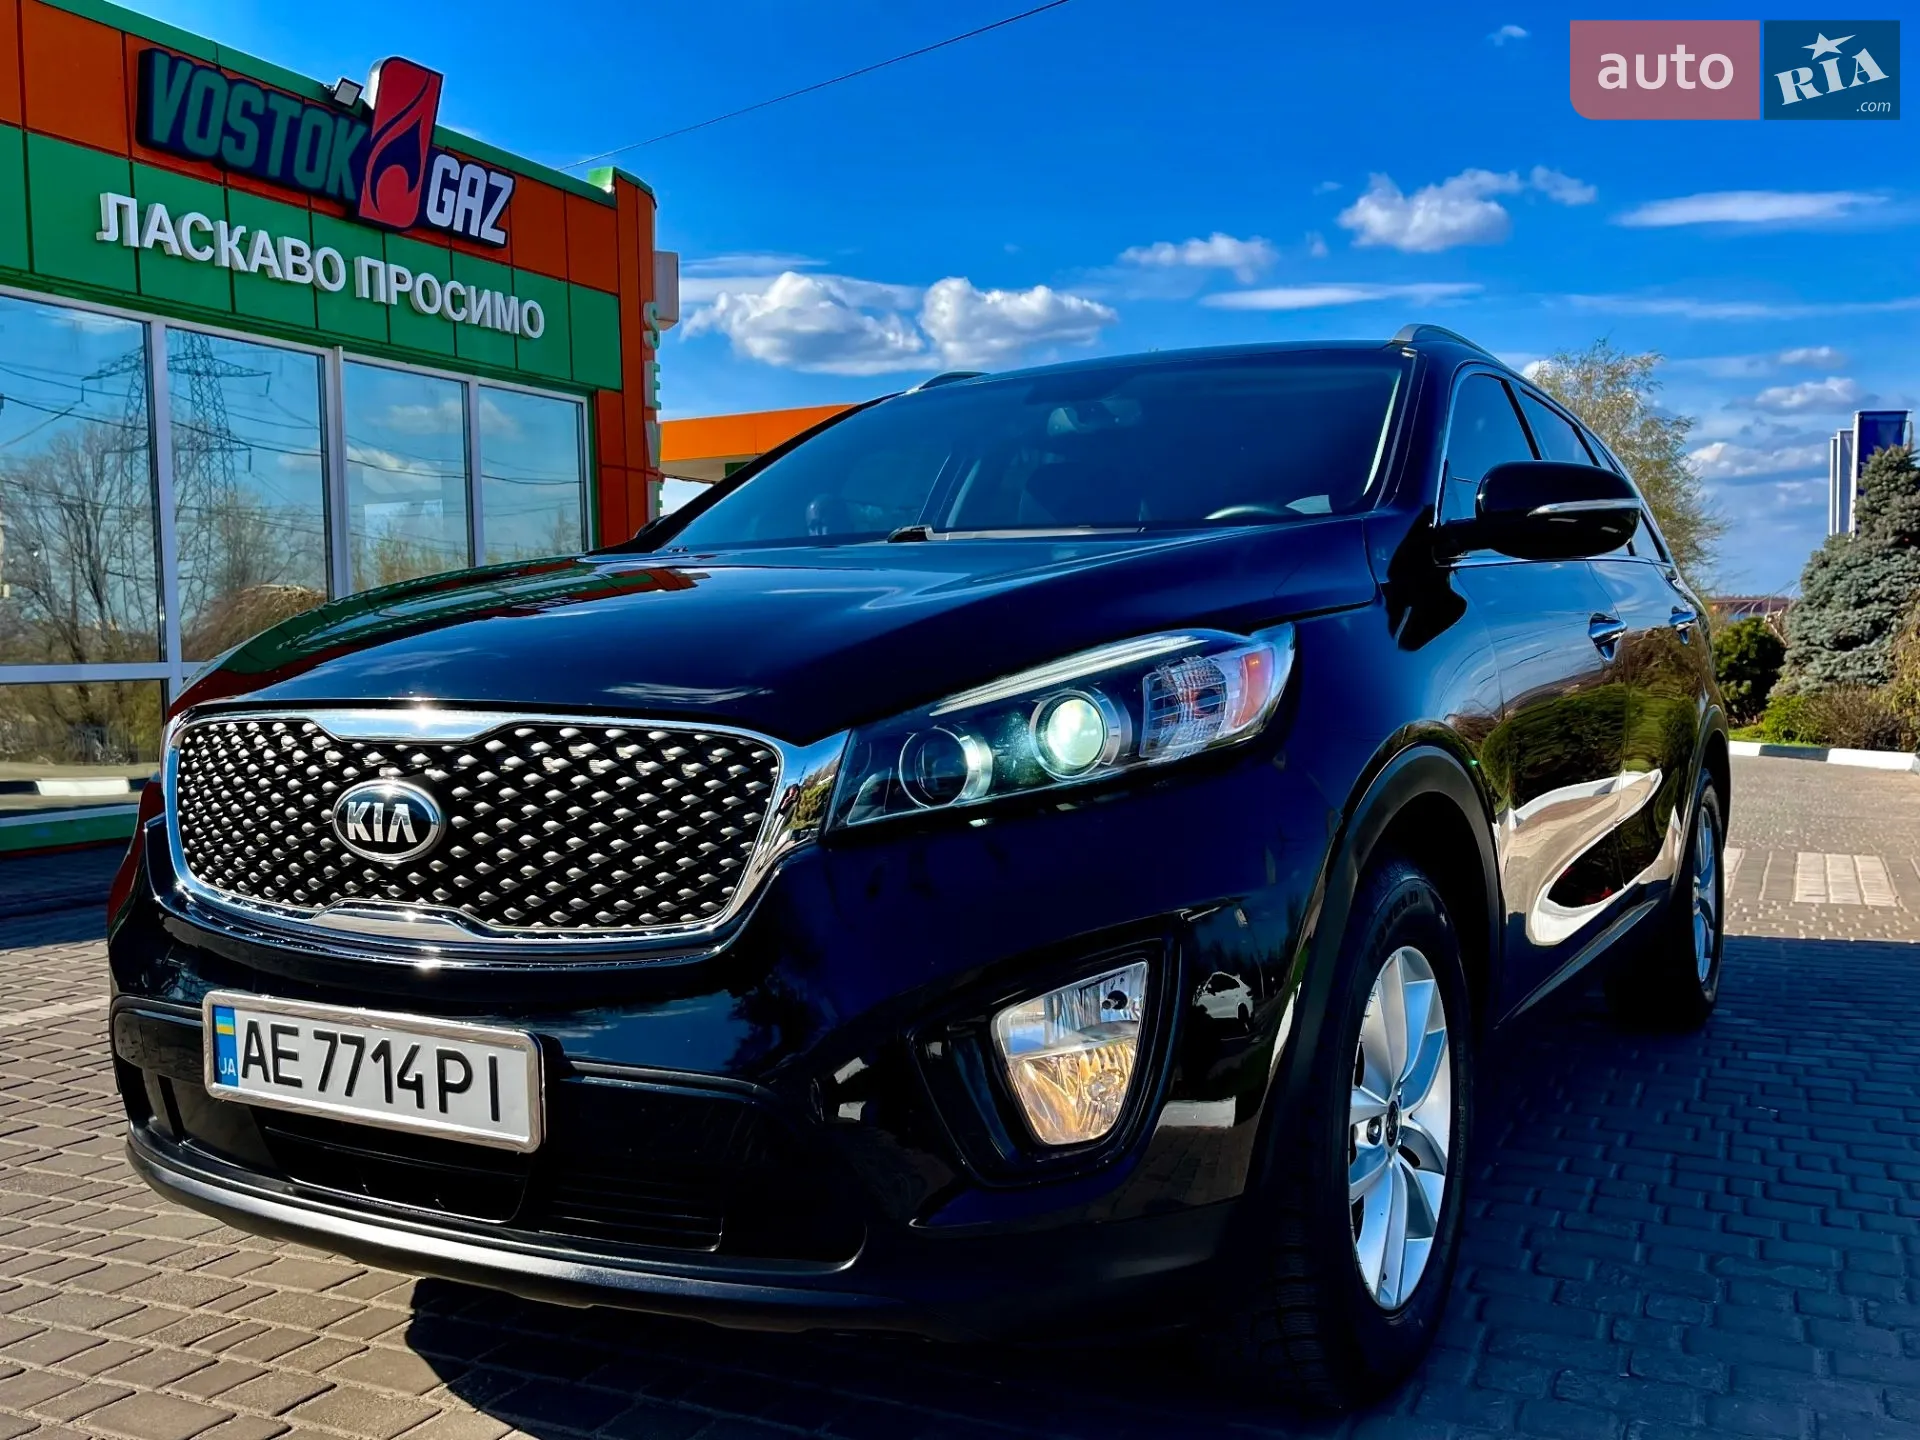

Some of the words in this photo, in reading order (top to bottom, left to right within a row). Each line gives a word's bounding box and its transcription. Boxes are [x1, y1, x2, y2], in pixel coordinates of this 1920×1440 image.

[149, 49, 369, 200] VOSTOK
[426, 154, 515, 247] GAZ
[96, 192, 347, 292] ЛАСКАВО
[354, 255, 545, 339] ПРОСИМО
[346, 801, 418, 843] KIA
[218, 1056, 237, 1077] UA
